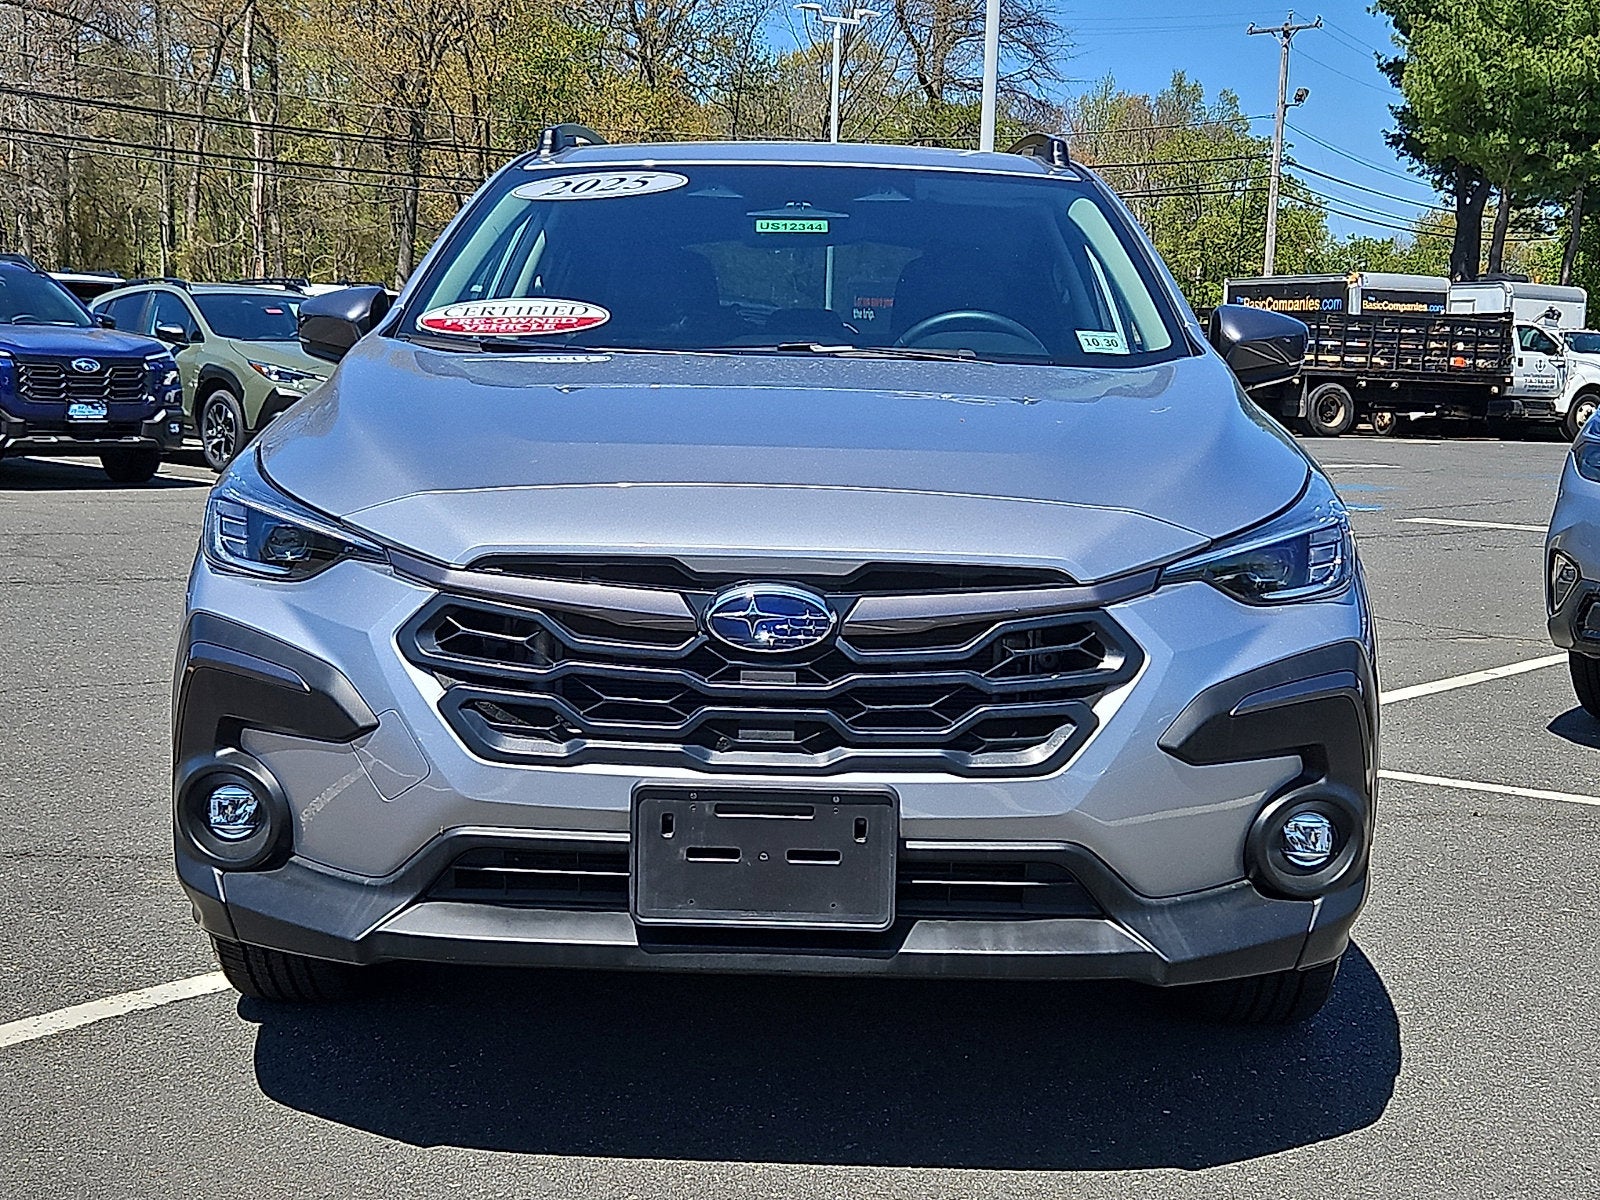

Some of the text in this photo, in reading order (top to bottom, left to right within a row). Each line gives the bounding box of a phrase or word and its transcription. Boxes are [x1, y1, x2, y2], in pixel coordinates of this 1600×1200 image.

[539, 175, 658, 197] 2025
[760, 222, 823, 231] US12344
[444, 305, 589, 317] CERTIFIED
[444, 317, 578, 325] PRE-OWNED
[462, 323, 558, 332] VEHICLE
[1084, 338, 1119, 348] 10 30
